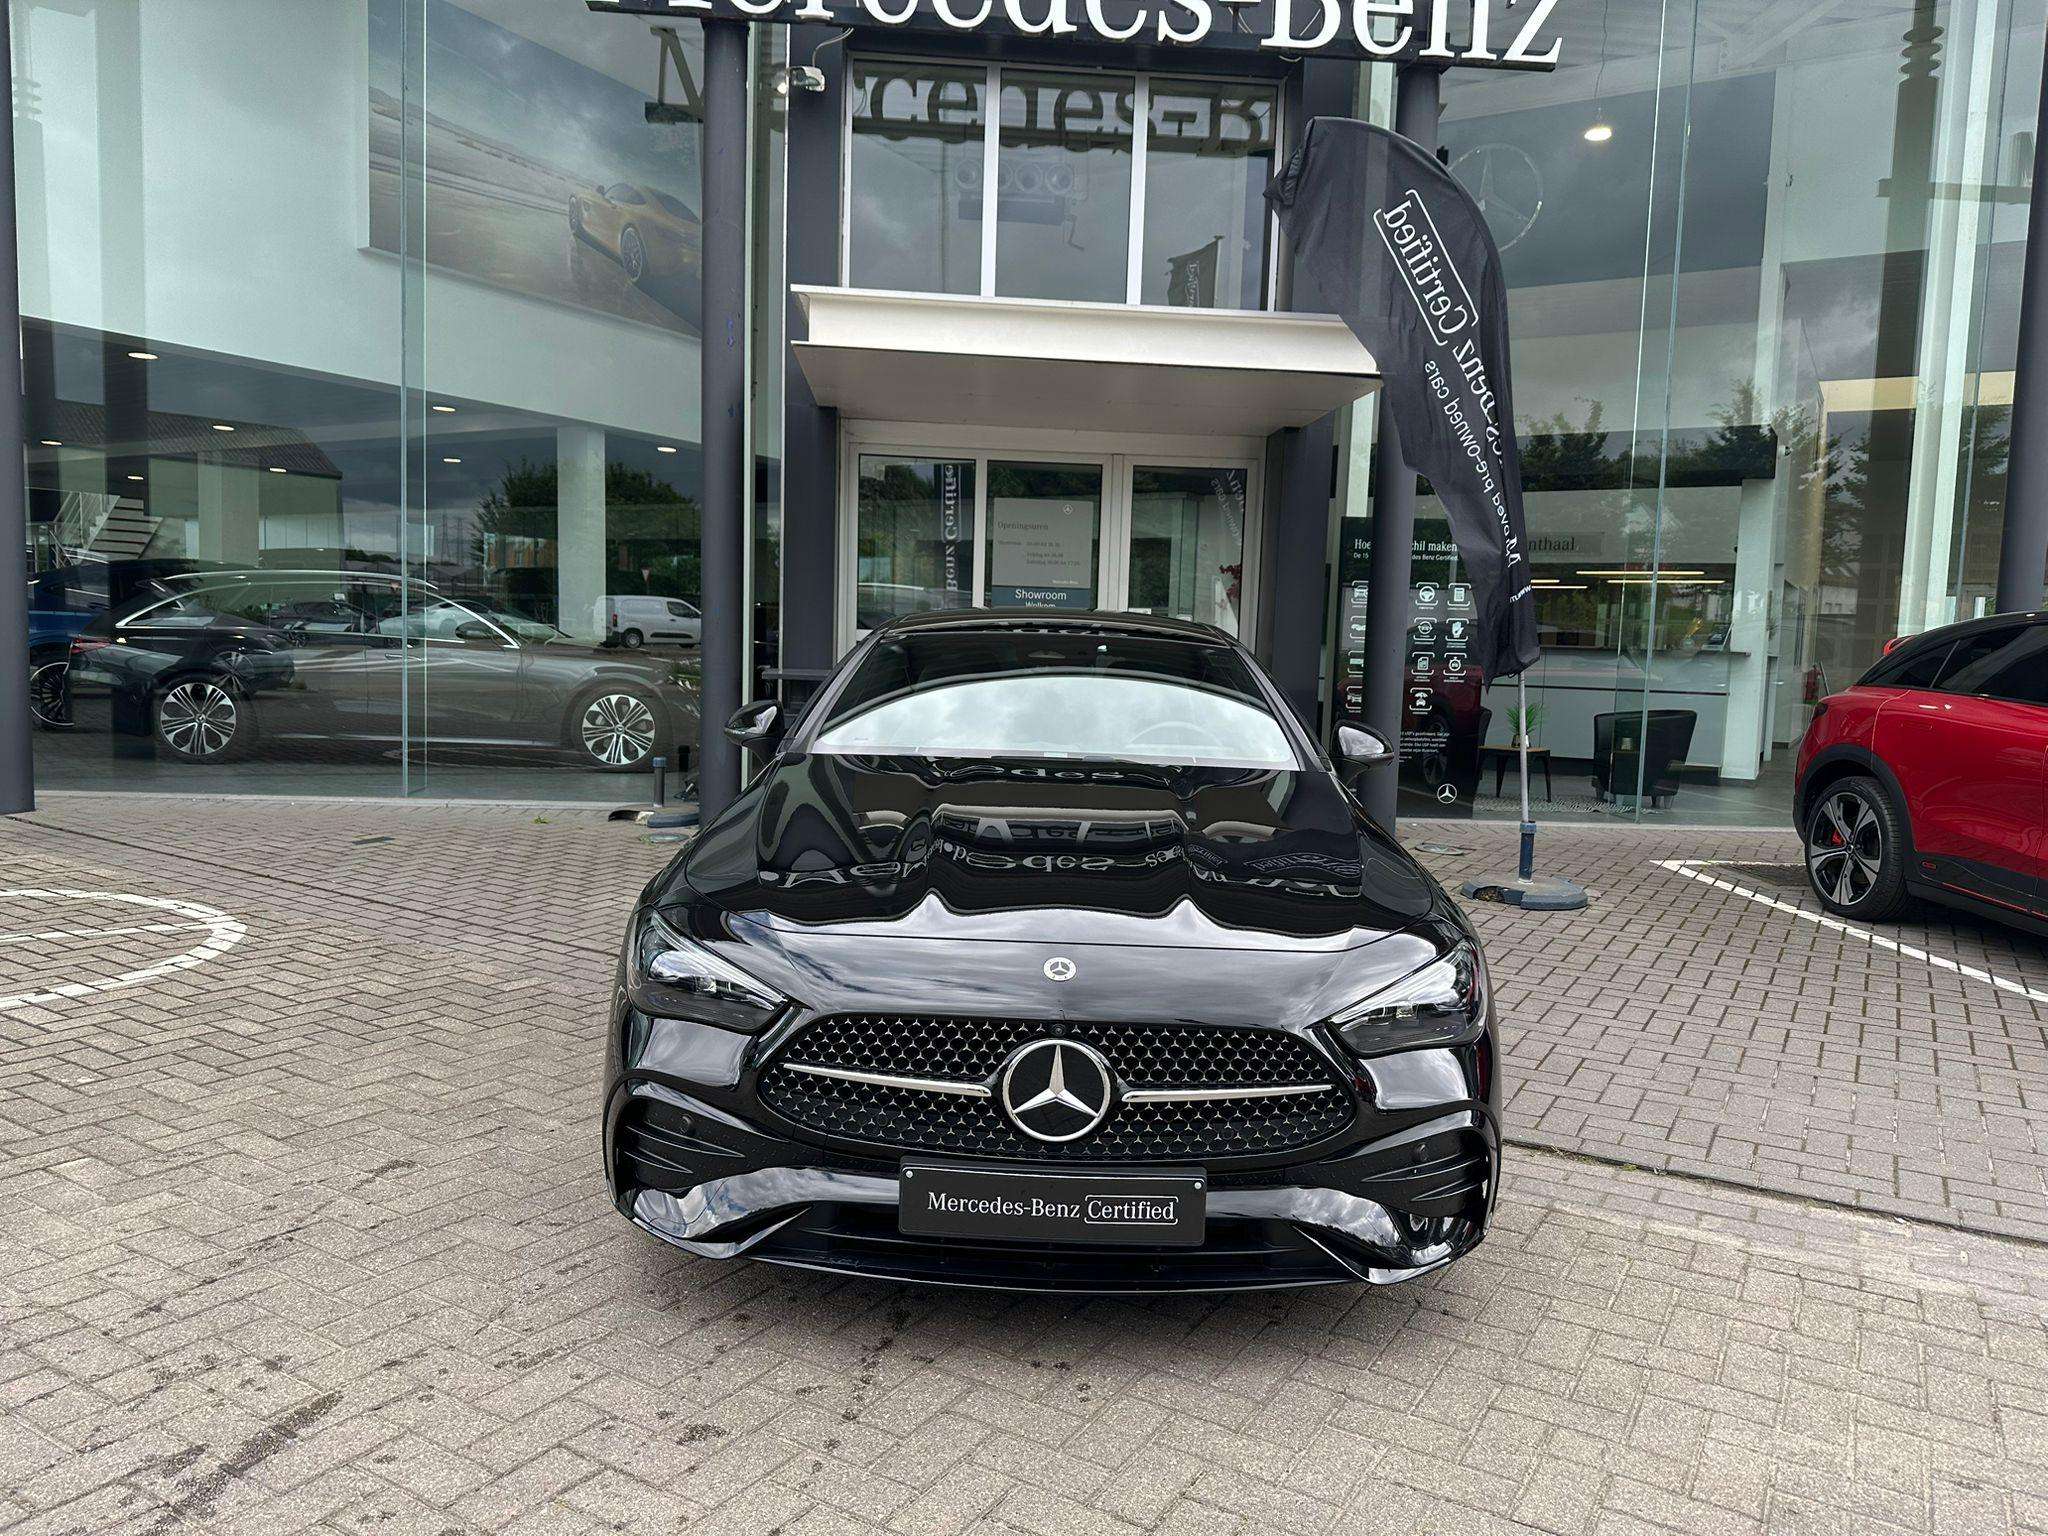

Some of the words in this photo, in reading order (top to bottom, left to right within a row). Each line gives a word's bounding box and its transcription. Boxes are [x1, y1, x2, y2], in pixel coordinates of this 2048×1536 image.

[1354, 539, 1372, 550] Hoe
[1427, 541, 1458, 552] maken
[1528, 536, 1575, 551] nthaal
[1015, 589, 1067, 600] Showroom
[927, 1191, 1080, 1219] Mercedes-Benz
[1087, 1199, 1175, 1220] Certified
